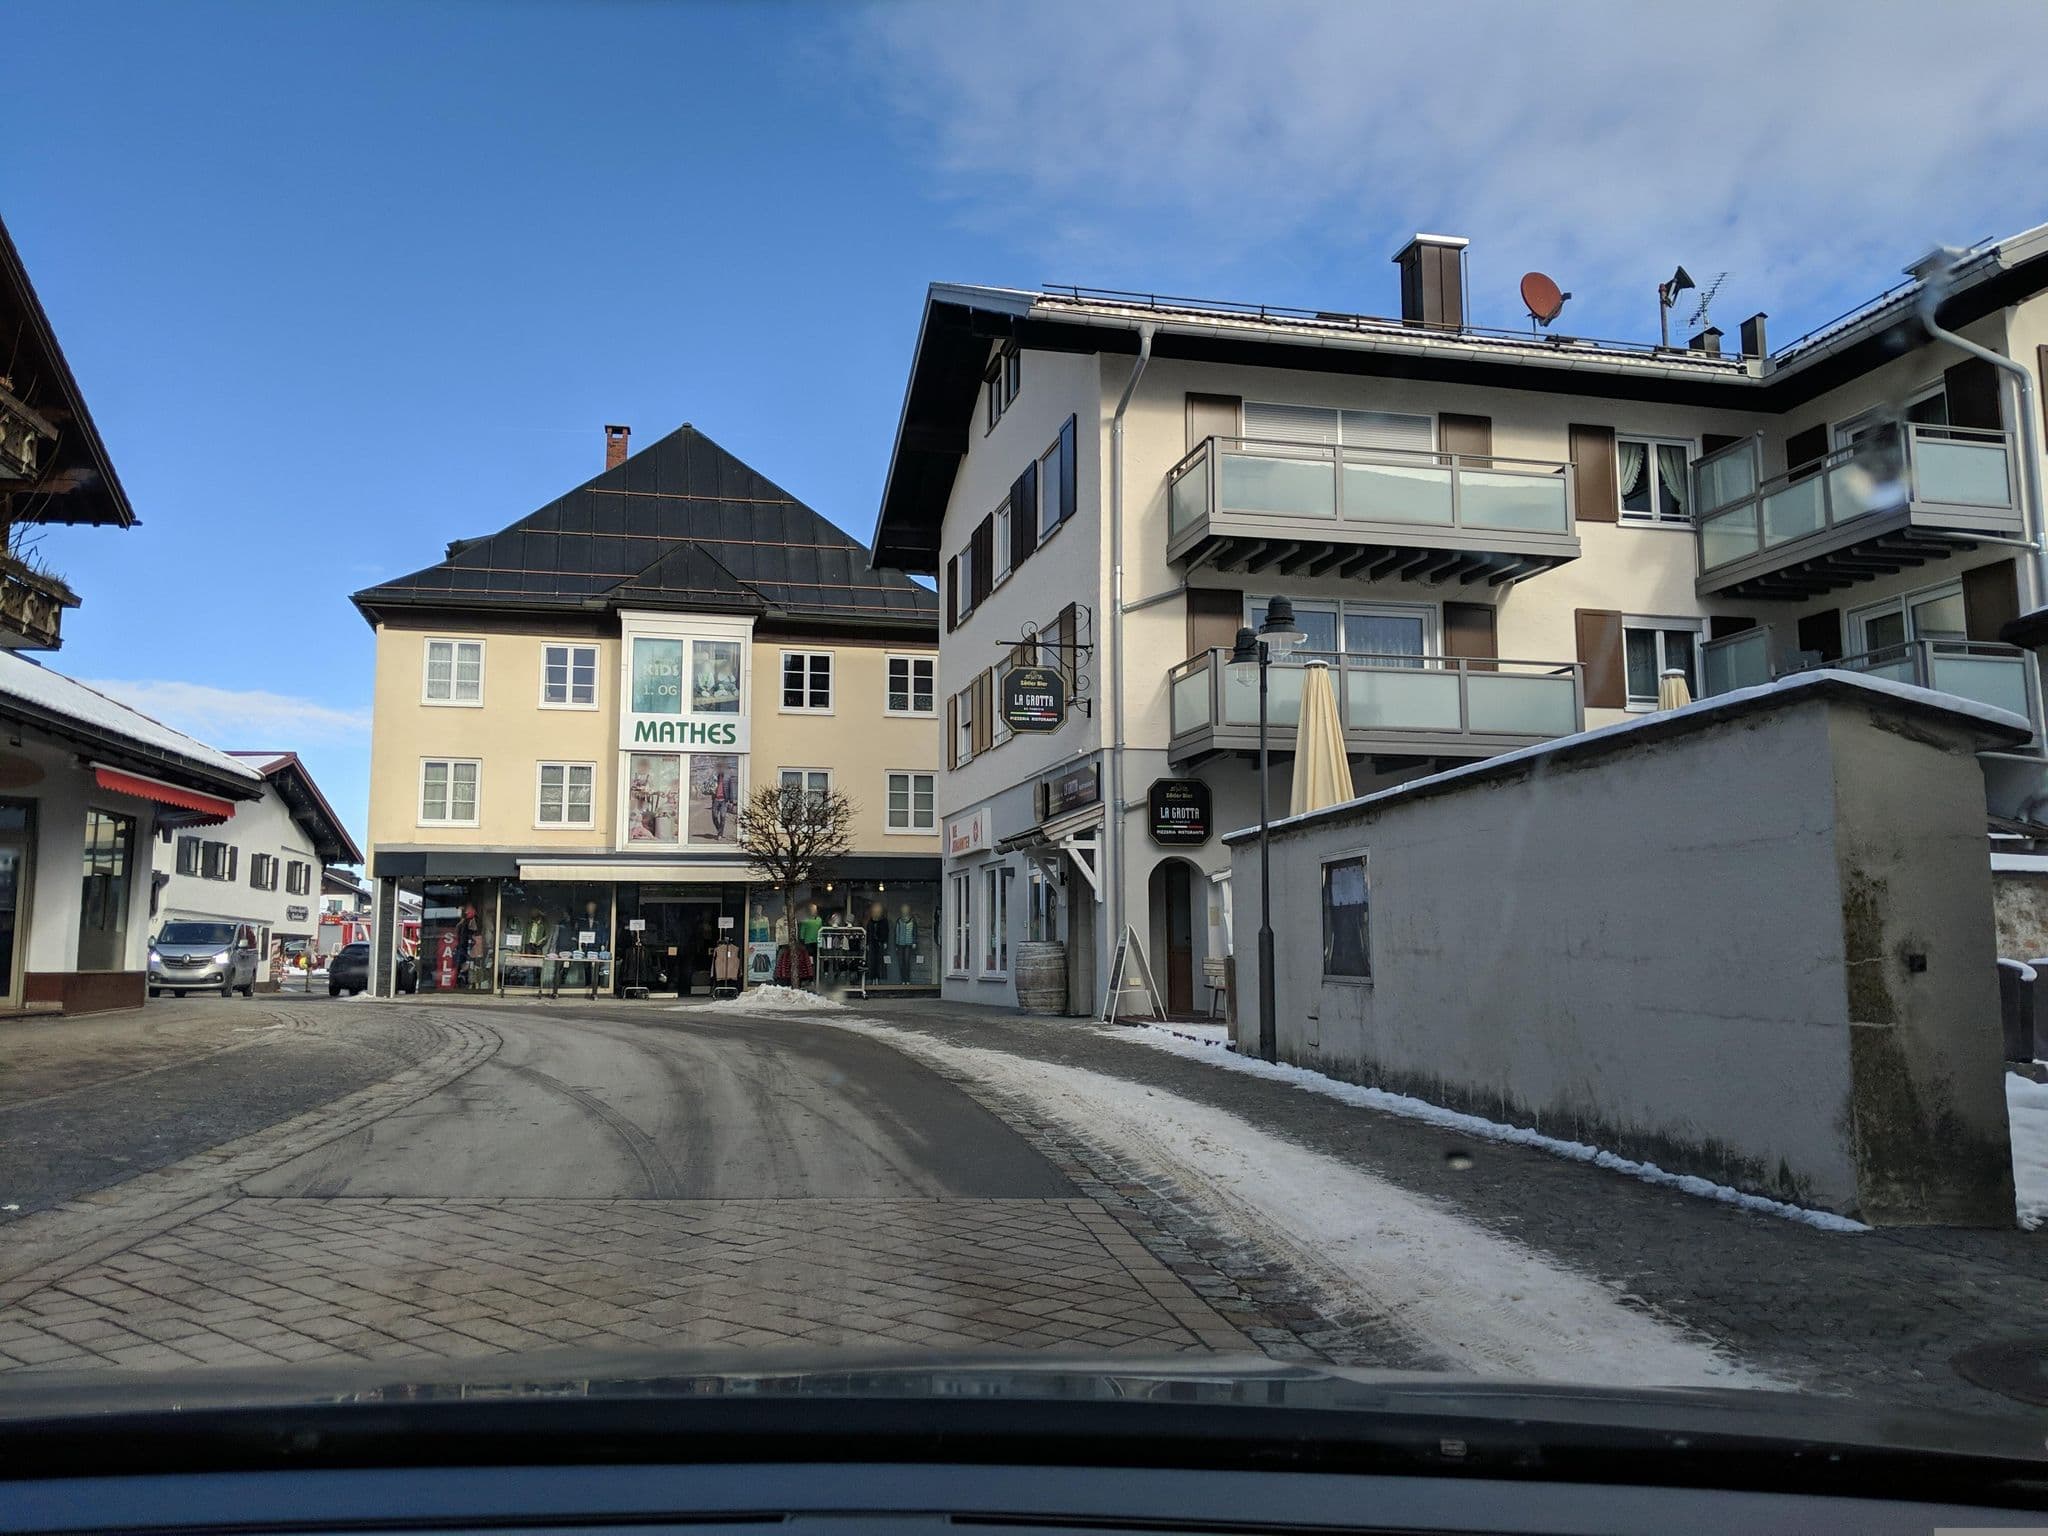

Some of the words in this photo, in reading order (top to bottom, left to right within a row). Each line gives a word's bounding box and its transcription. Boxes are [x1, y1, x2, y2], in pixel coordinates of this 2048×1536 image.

[644, 662, 680, 677] KIDS
[658, 684, 678, 696] OG
[1014, 694, 1024, 706] LA
[1026, 694, 1054, 707] GROTTA
[634, 720, 737, 745] MATHES
[1160, 807, 1170, 819] LA
[1171, 807, 1199, 819] GROTTA
[441, 931, 455, 987] SALE
